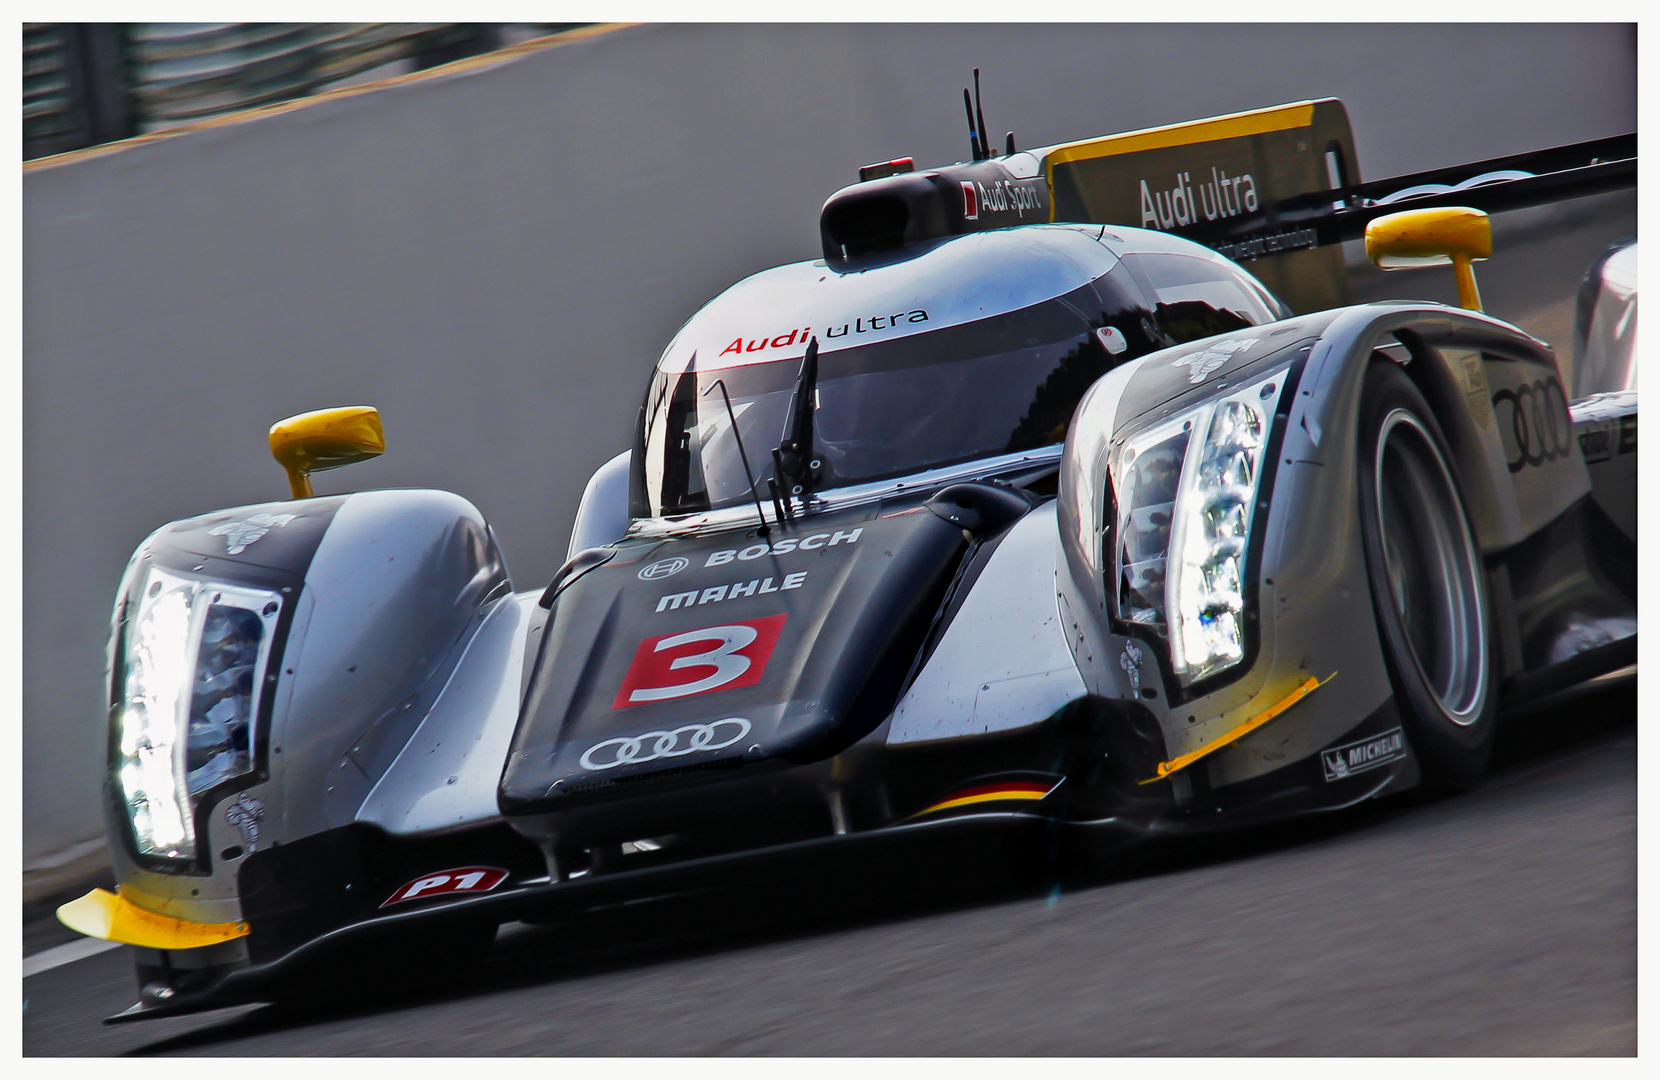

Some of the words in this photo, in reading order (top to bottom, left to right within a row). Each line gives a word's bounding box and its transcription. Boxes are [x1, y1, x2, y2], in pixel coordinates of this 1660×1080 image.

[978, 181, 1009, 212] Audi
[1003, 180, 1042, 219] Sport
[1140, 171, 1198, 230] Audi
[1200, 166, 1259, 221] ultra
[719, 326, 811, 357] Audi
[826, 308, 930, 339] ultra
[704, 527, 864, 568] BOSCH
[655, 571, 808, 613] MAHLE
[628, 624, 758, 702] 3
[1349, 732, 1403, 766] MICHELIN
[401, 871, 487, 899] P1
